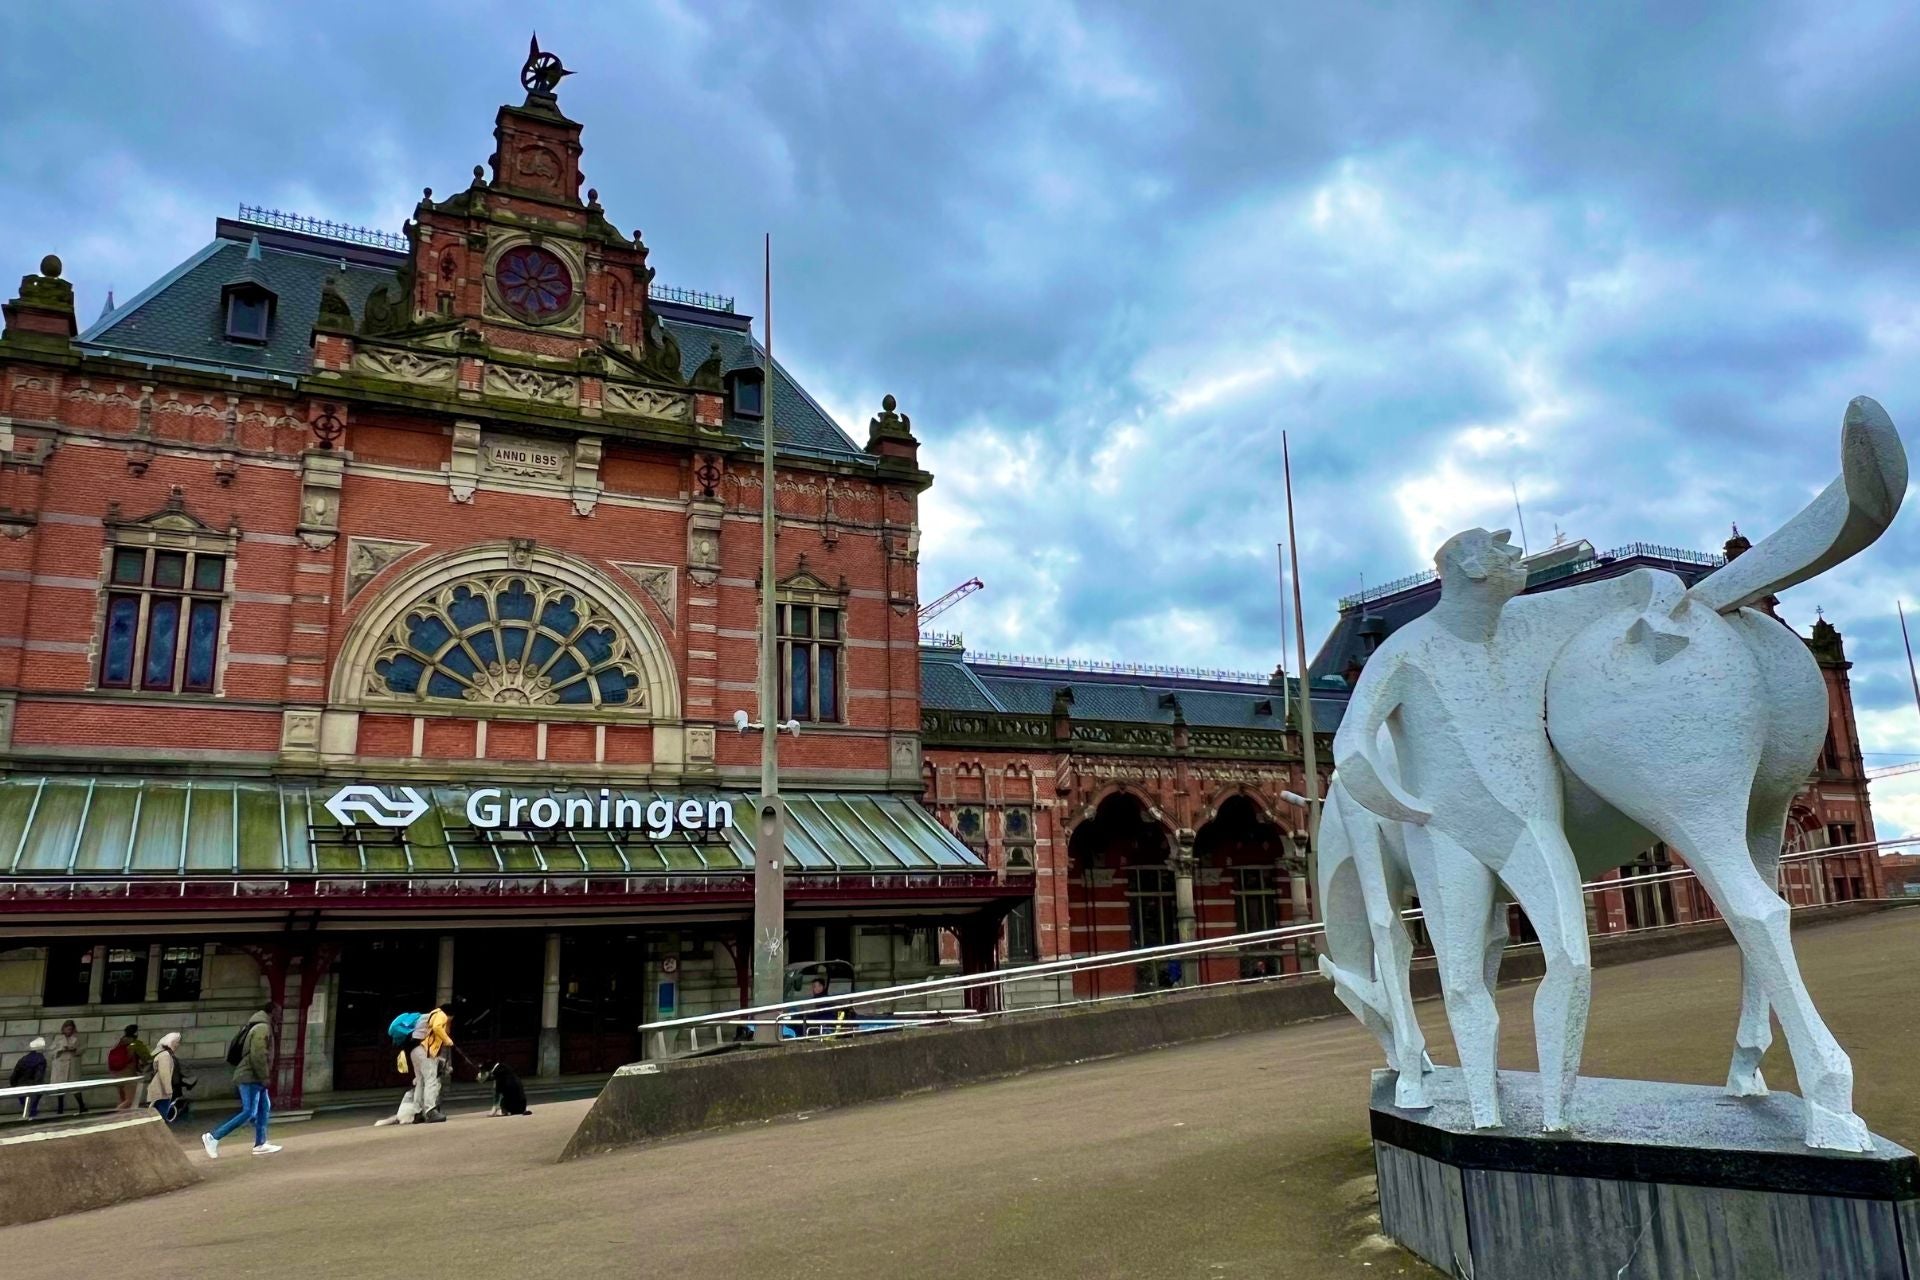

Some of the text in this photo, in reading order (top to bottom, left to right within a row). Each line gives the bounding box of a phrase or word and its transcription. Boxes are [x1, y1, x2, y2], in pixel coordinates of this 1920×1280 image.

[495, 449, 557, 466] ANNO 1895
[466, 788, 733, 839] Groningen
